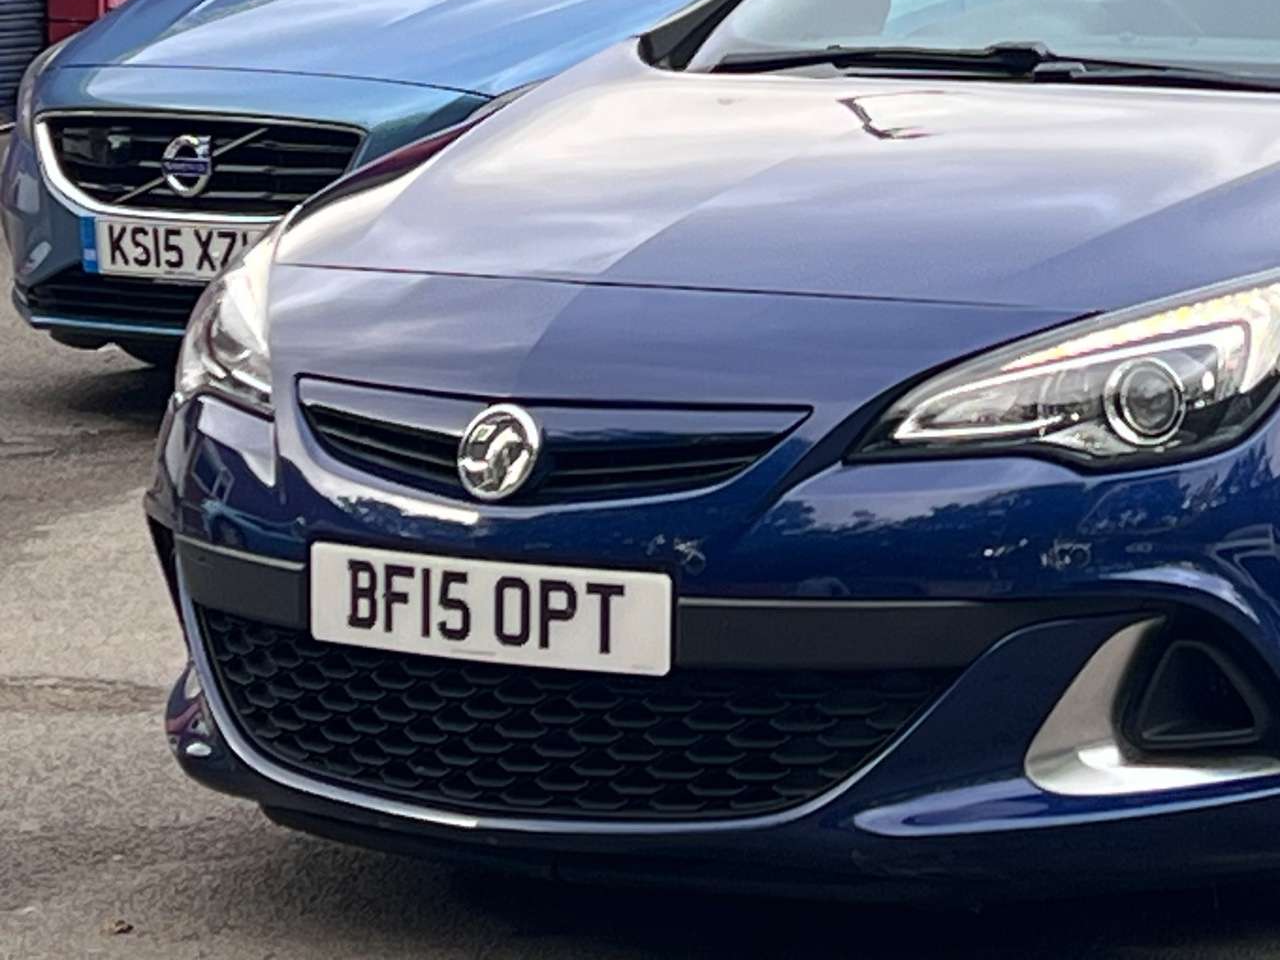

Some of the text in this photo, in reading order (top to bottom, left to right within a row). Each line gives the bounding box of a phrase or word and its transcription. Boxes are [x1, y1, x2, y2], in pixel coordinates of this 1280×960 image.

[108, 224, 184, 269] KS15
[346, 558, 626, 655] BF15 OPT
